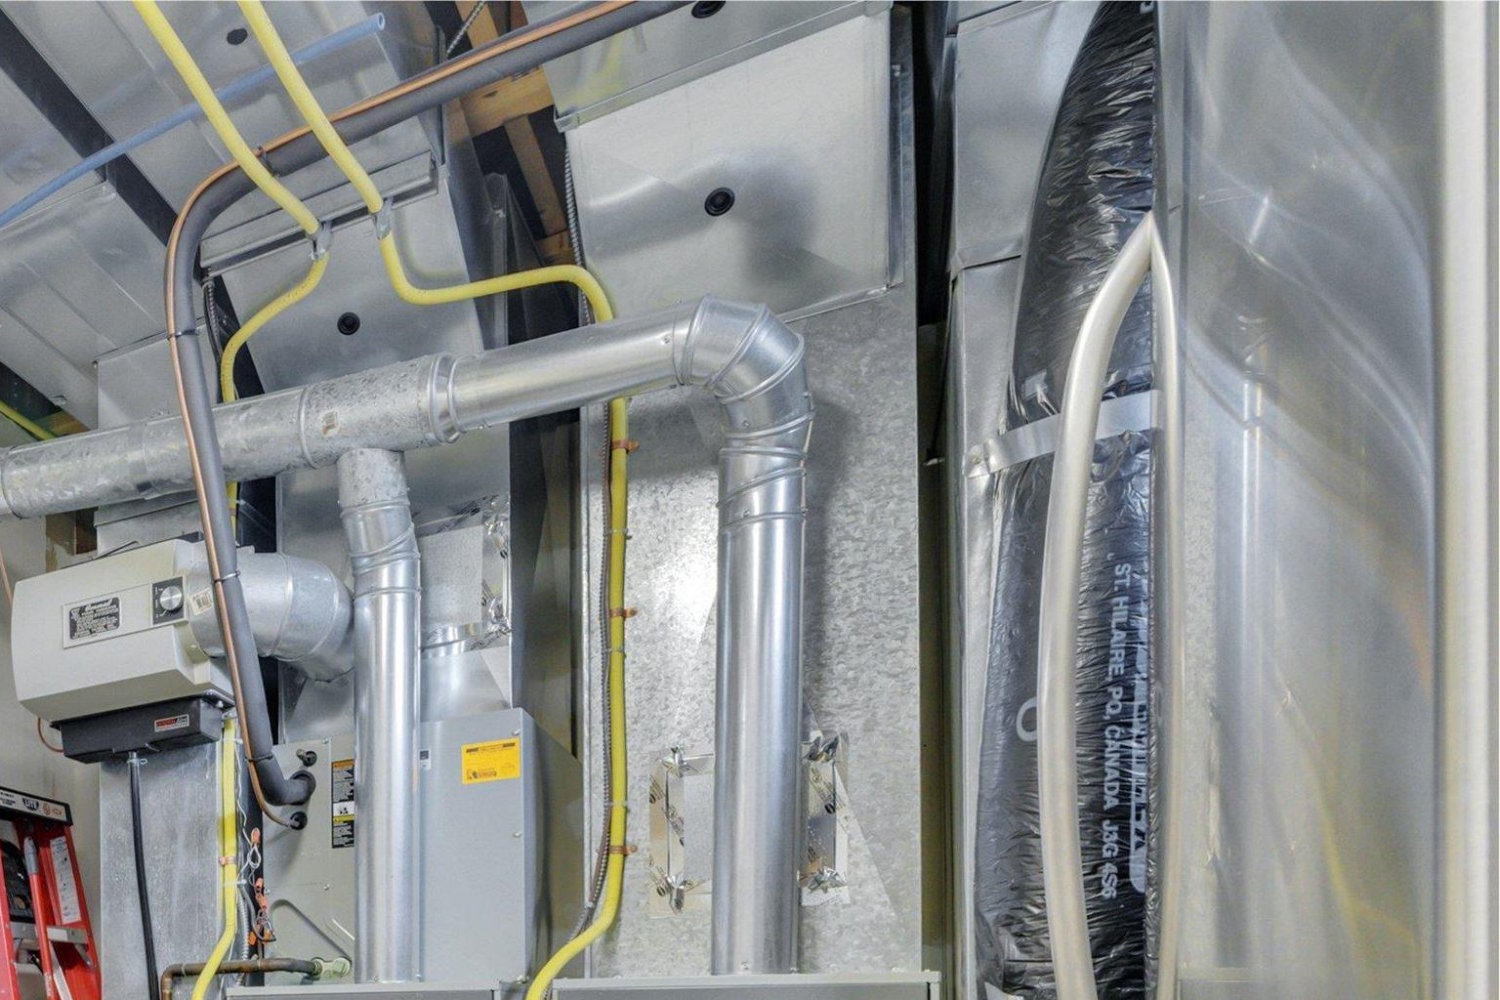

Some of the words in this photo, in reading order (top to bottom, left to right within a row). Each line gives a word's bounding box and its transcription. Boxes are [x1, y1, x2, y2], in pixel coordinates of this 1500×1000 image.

[1113, 563, 1132, 591] ST.
[1105, 596, 1130, 682] HILAIRE,
[1103, 686, 1124, 720] PQ,
[1102, 726, 1122, 811] CANADA
[1101, 820, 1119, 858] J3G
